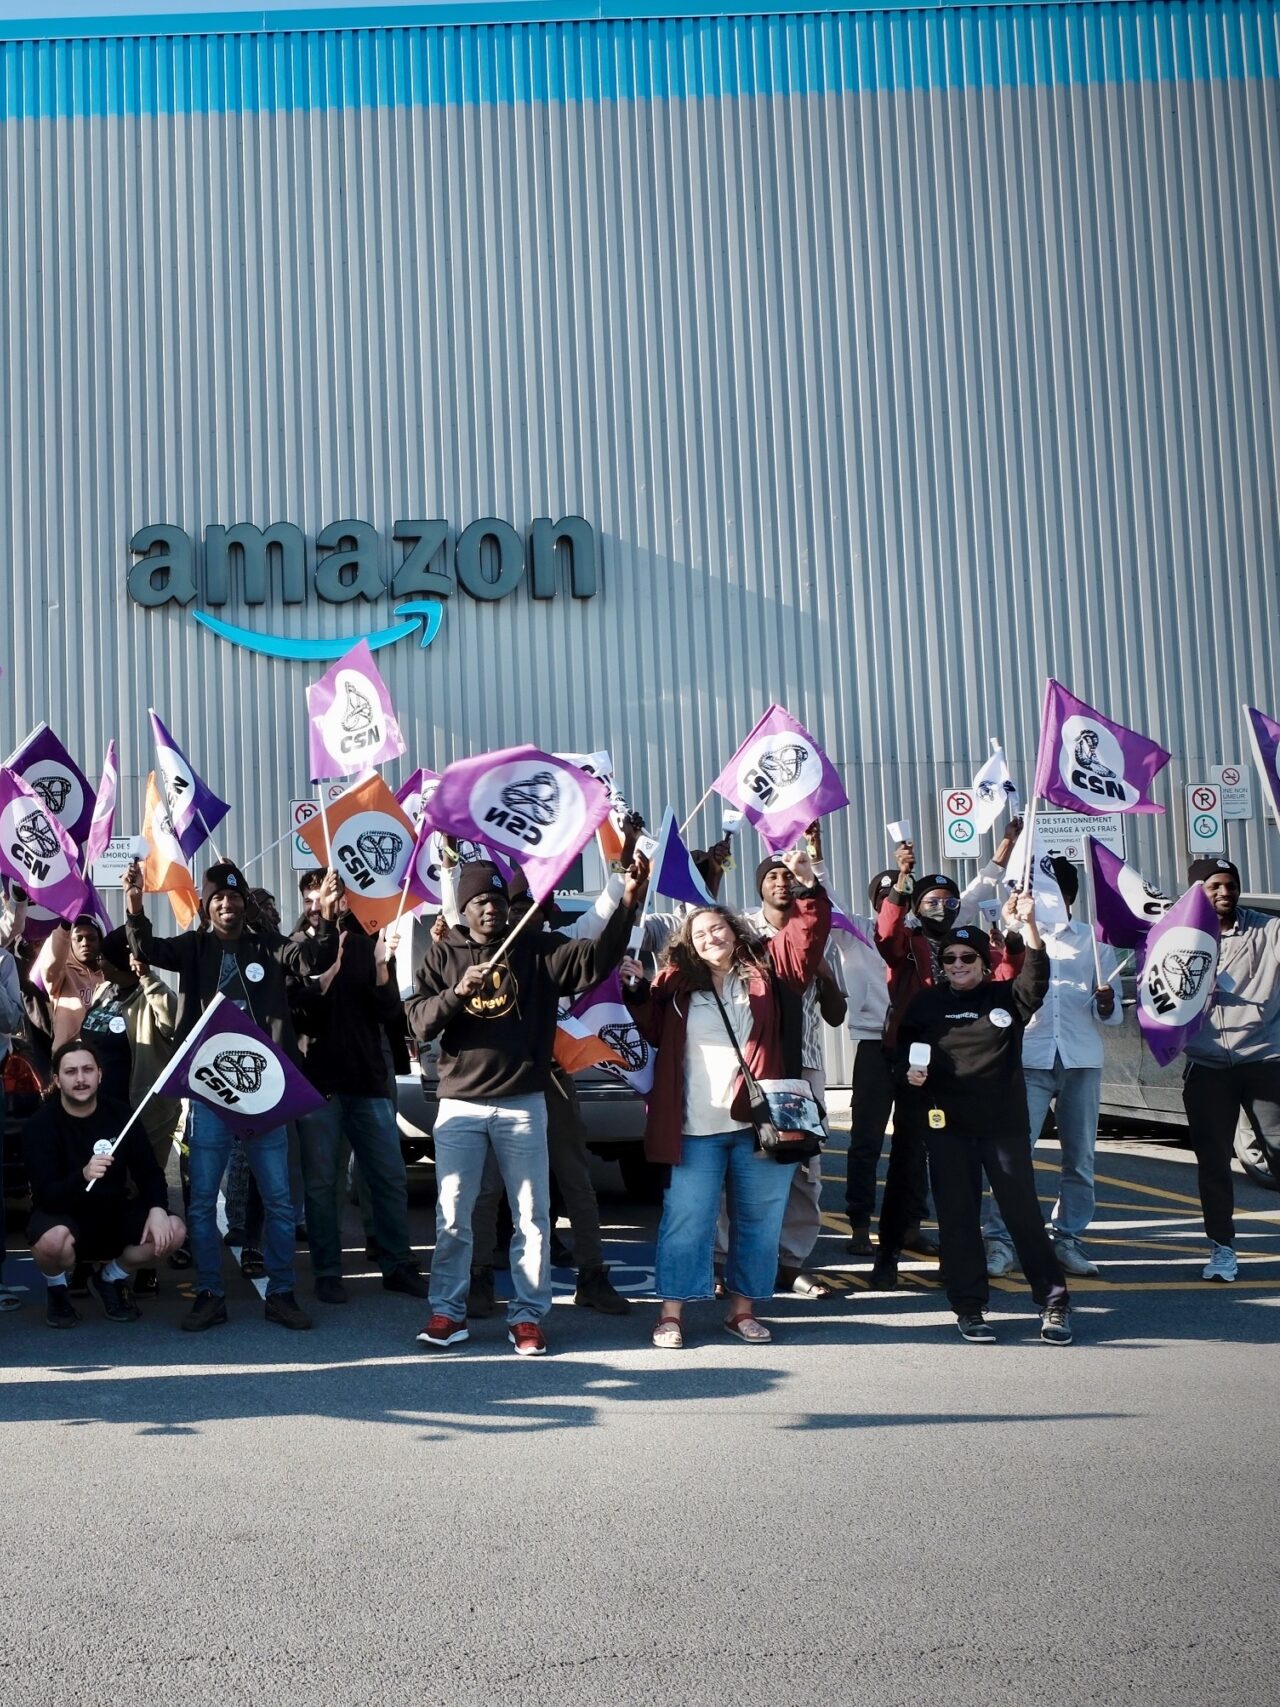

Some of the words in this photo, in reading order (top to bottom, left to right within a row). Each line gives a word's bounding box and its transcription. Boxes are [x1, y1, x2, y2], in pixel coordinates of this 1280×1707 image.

[126, 515, 600, 607] amazon
[340, 724, 380, 754] CSN
[743, 768, 780, 808] CSN
[1072, 769, 1127, 802] CSN
[1042, 817, 1051, 825] DE
[1053, 816, 1112, 824] STATIONNEMENT
[11, 843, 51, 881] CSN
[337, 844, 376, 890] CSN
[471, 994, 507, 1010] drew
[195, 1067, 240, 1105] CSN
